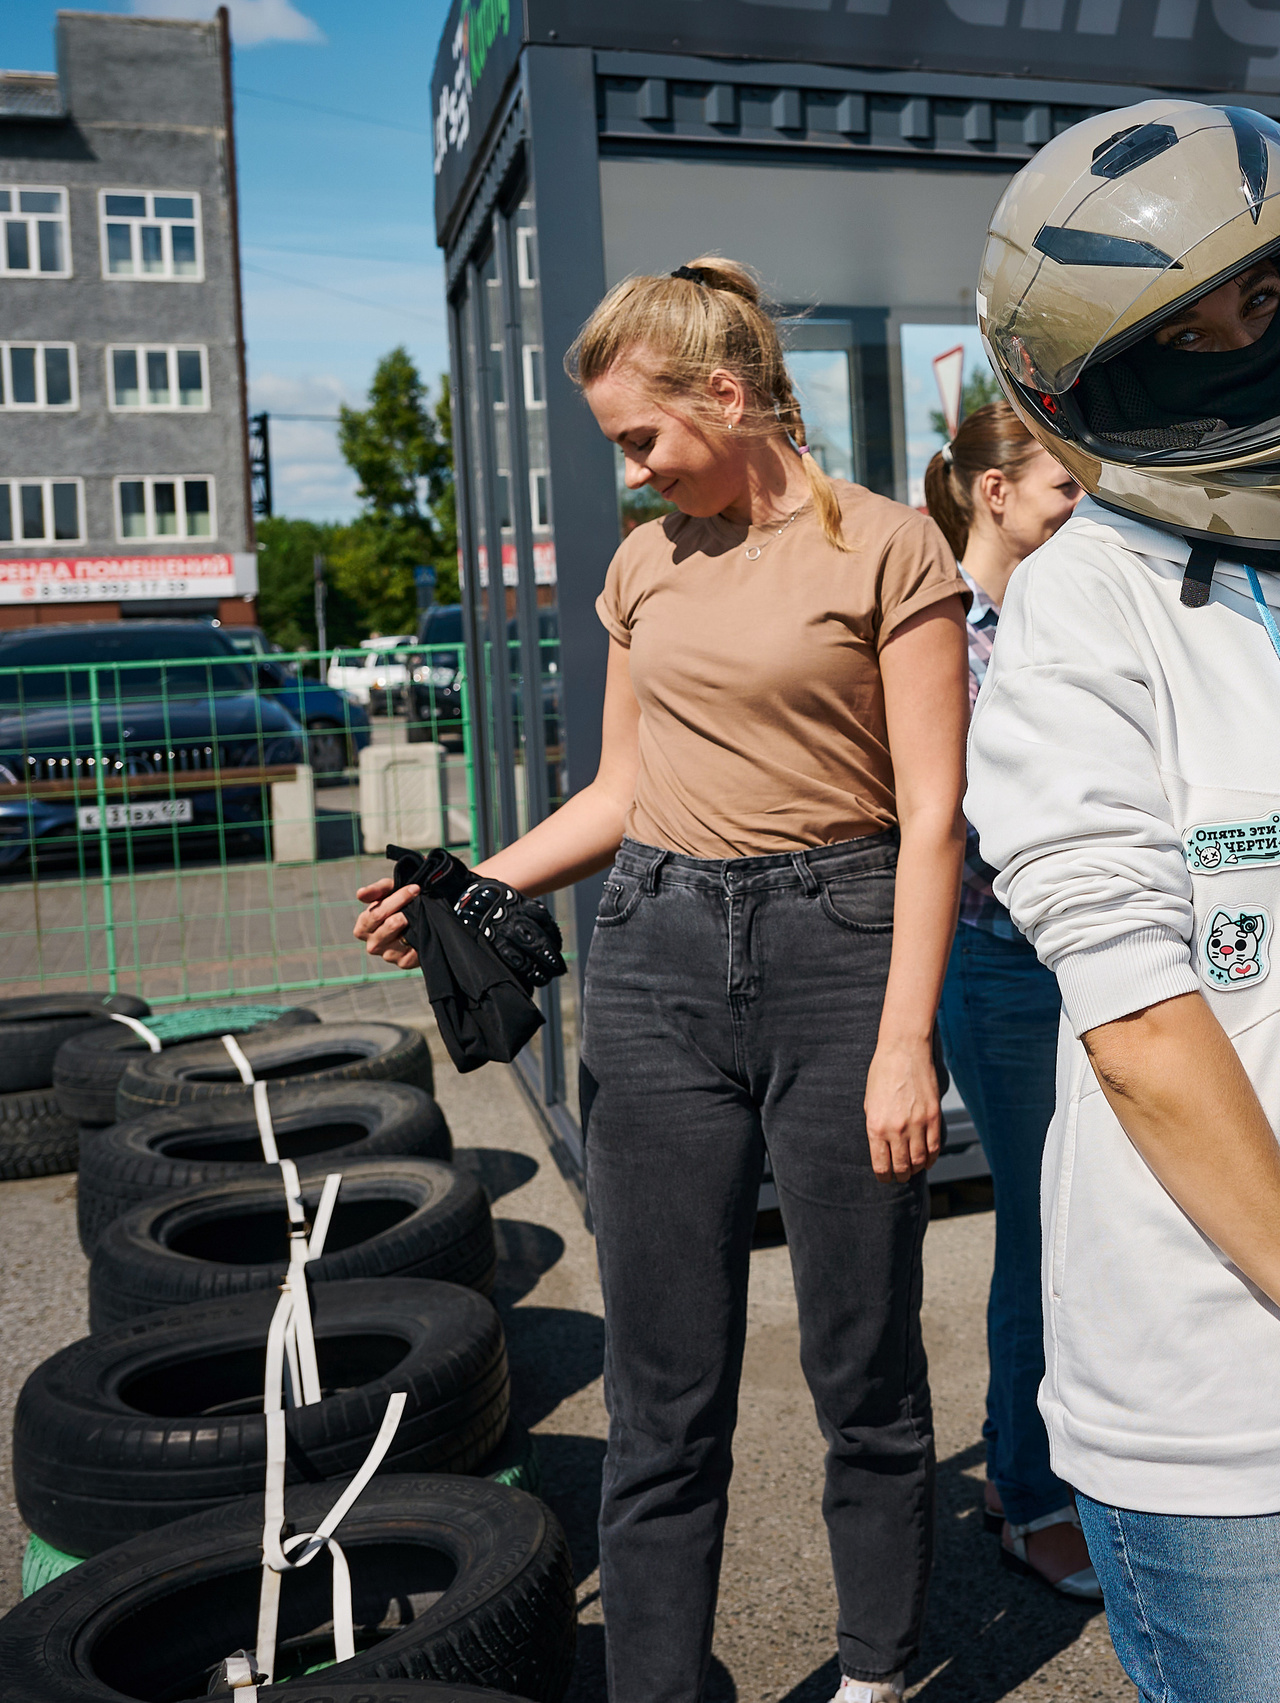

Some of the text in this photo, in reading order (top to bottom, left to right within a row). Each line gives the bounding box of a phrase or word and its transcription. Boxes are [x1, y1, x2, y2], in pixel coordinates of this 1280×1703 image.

[75, 554, 229, 580] ПОМЕЩЕНИЙ
[1249, 825, 1277, 836] эти
[1224, 837, 1278, 853] ЧЕРТИ
